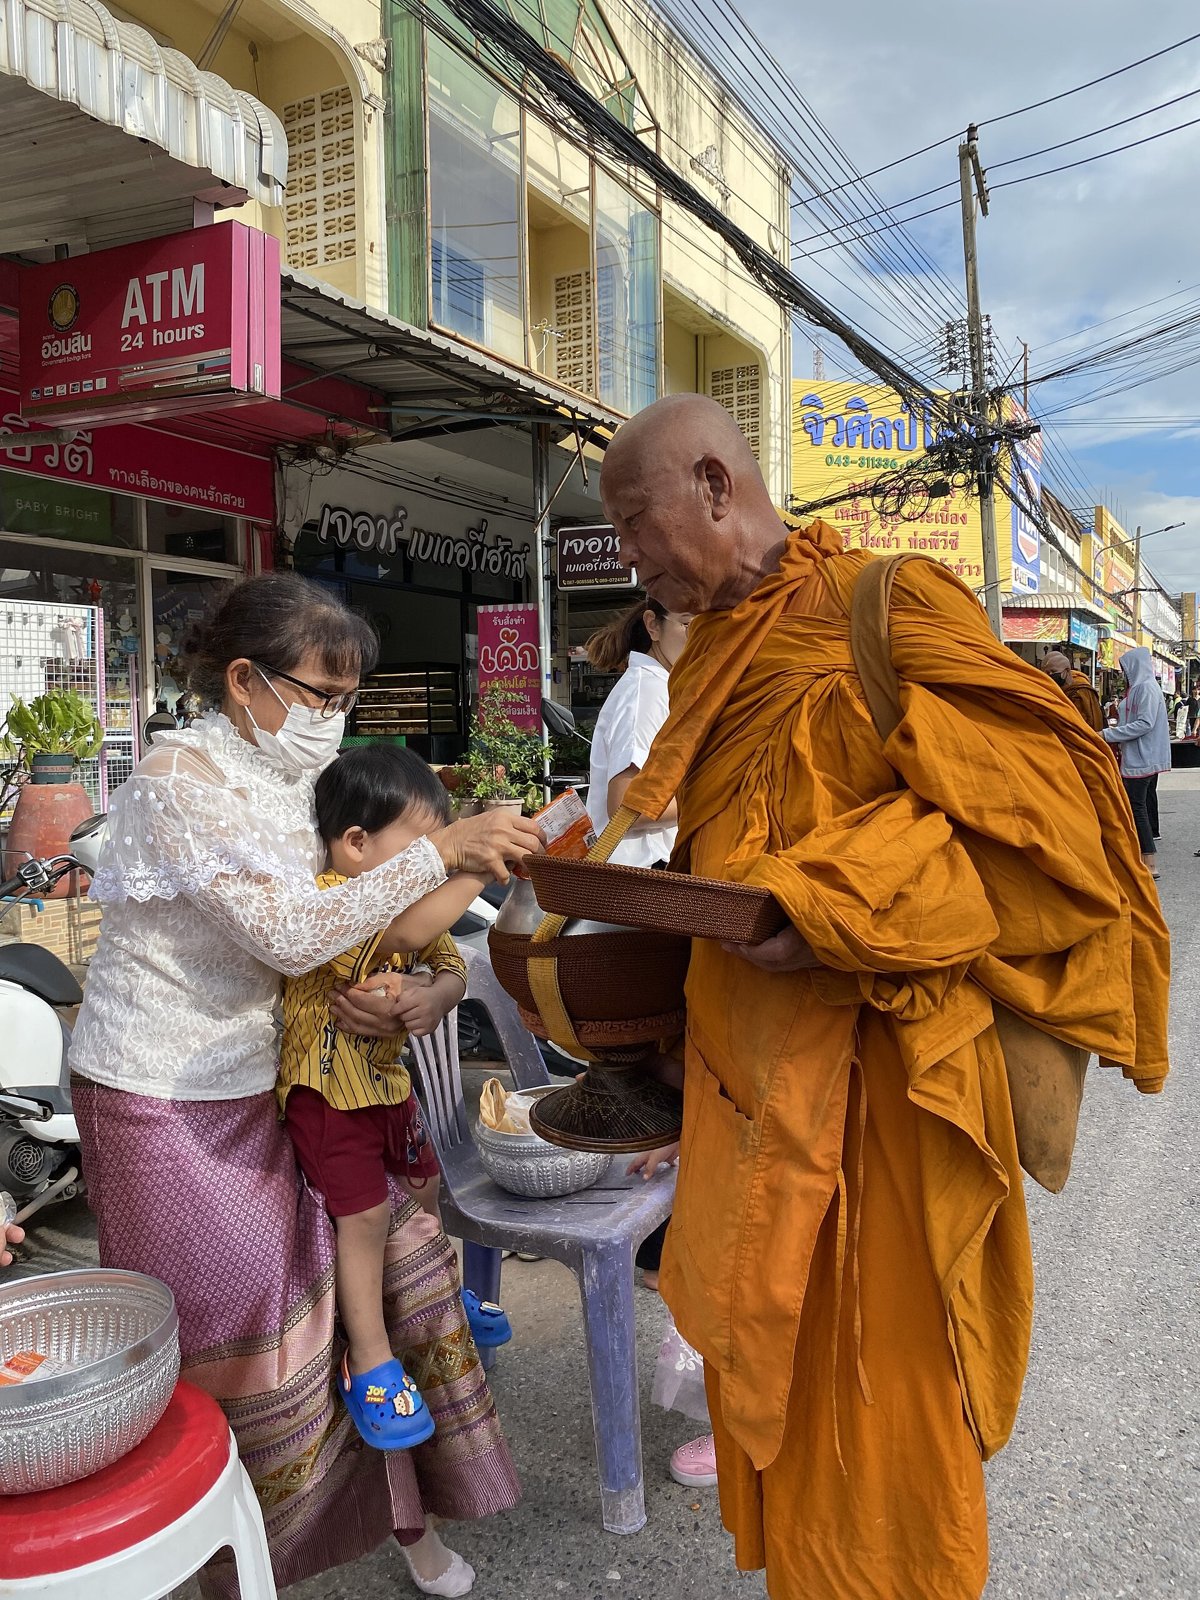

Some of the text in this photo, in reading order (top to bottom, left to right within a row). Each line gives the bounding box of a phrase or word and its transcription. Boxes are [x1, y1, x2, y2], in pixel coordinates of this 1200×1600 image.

[120, 262, 206, 329] ATM
[120, 322, 205, 352] 24 hours
[109, 467, 246, 509] ทางเลือกของคนรักสวย
[16, 498, 100, 522] BABY BRIGHT
[319, 507, 408, 553] เจอาร์
[562, 535, 621, 556] เจอาร
